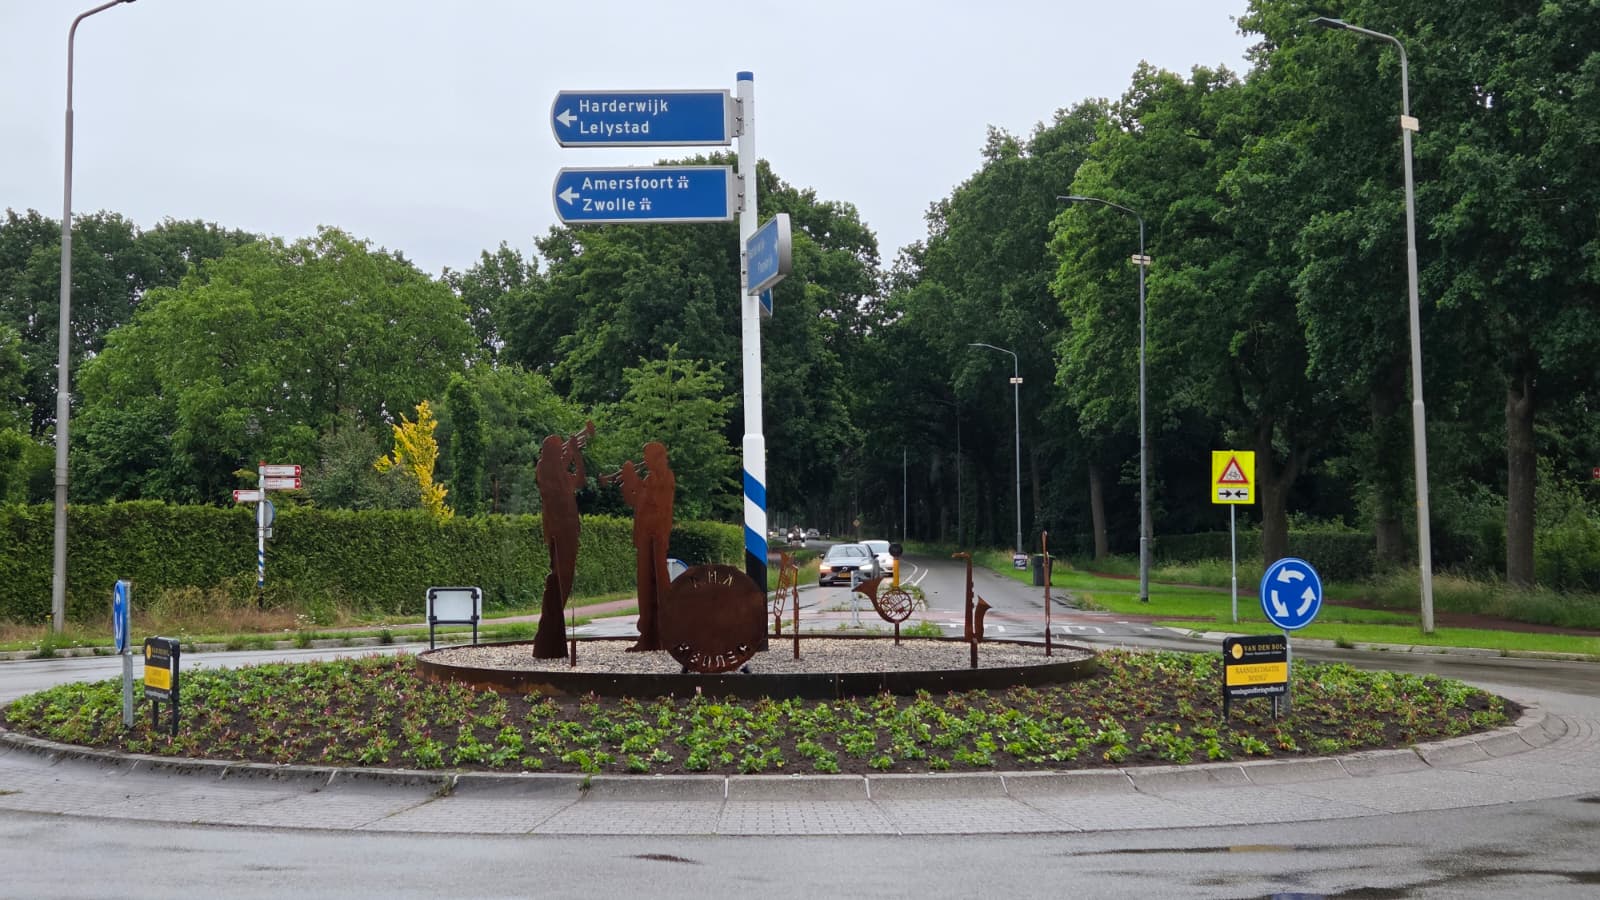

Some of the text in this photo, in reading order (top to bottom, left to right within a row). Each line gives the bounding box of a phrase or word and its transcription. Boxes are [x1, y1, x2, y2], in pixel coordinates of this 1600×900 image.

[579, 99, 669, 116] Harderwijk
[580, 121, 649, 136] Lelystad
[582, 175, 673, 190] Amersfoort
[582, 197, 636, 212] Zwolle
